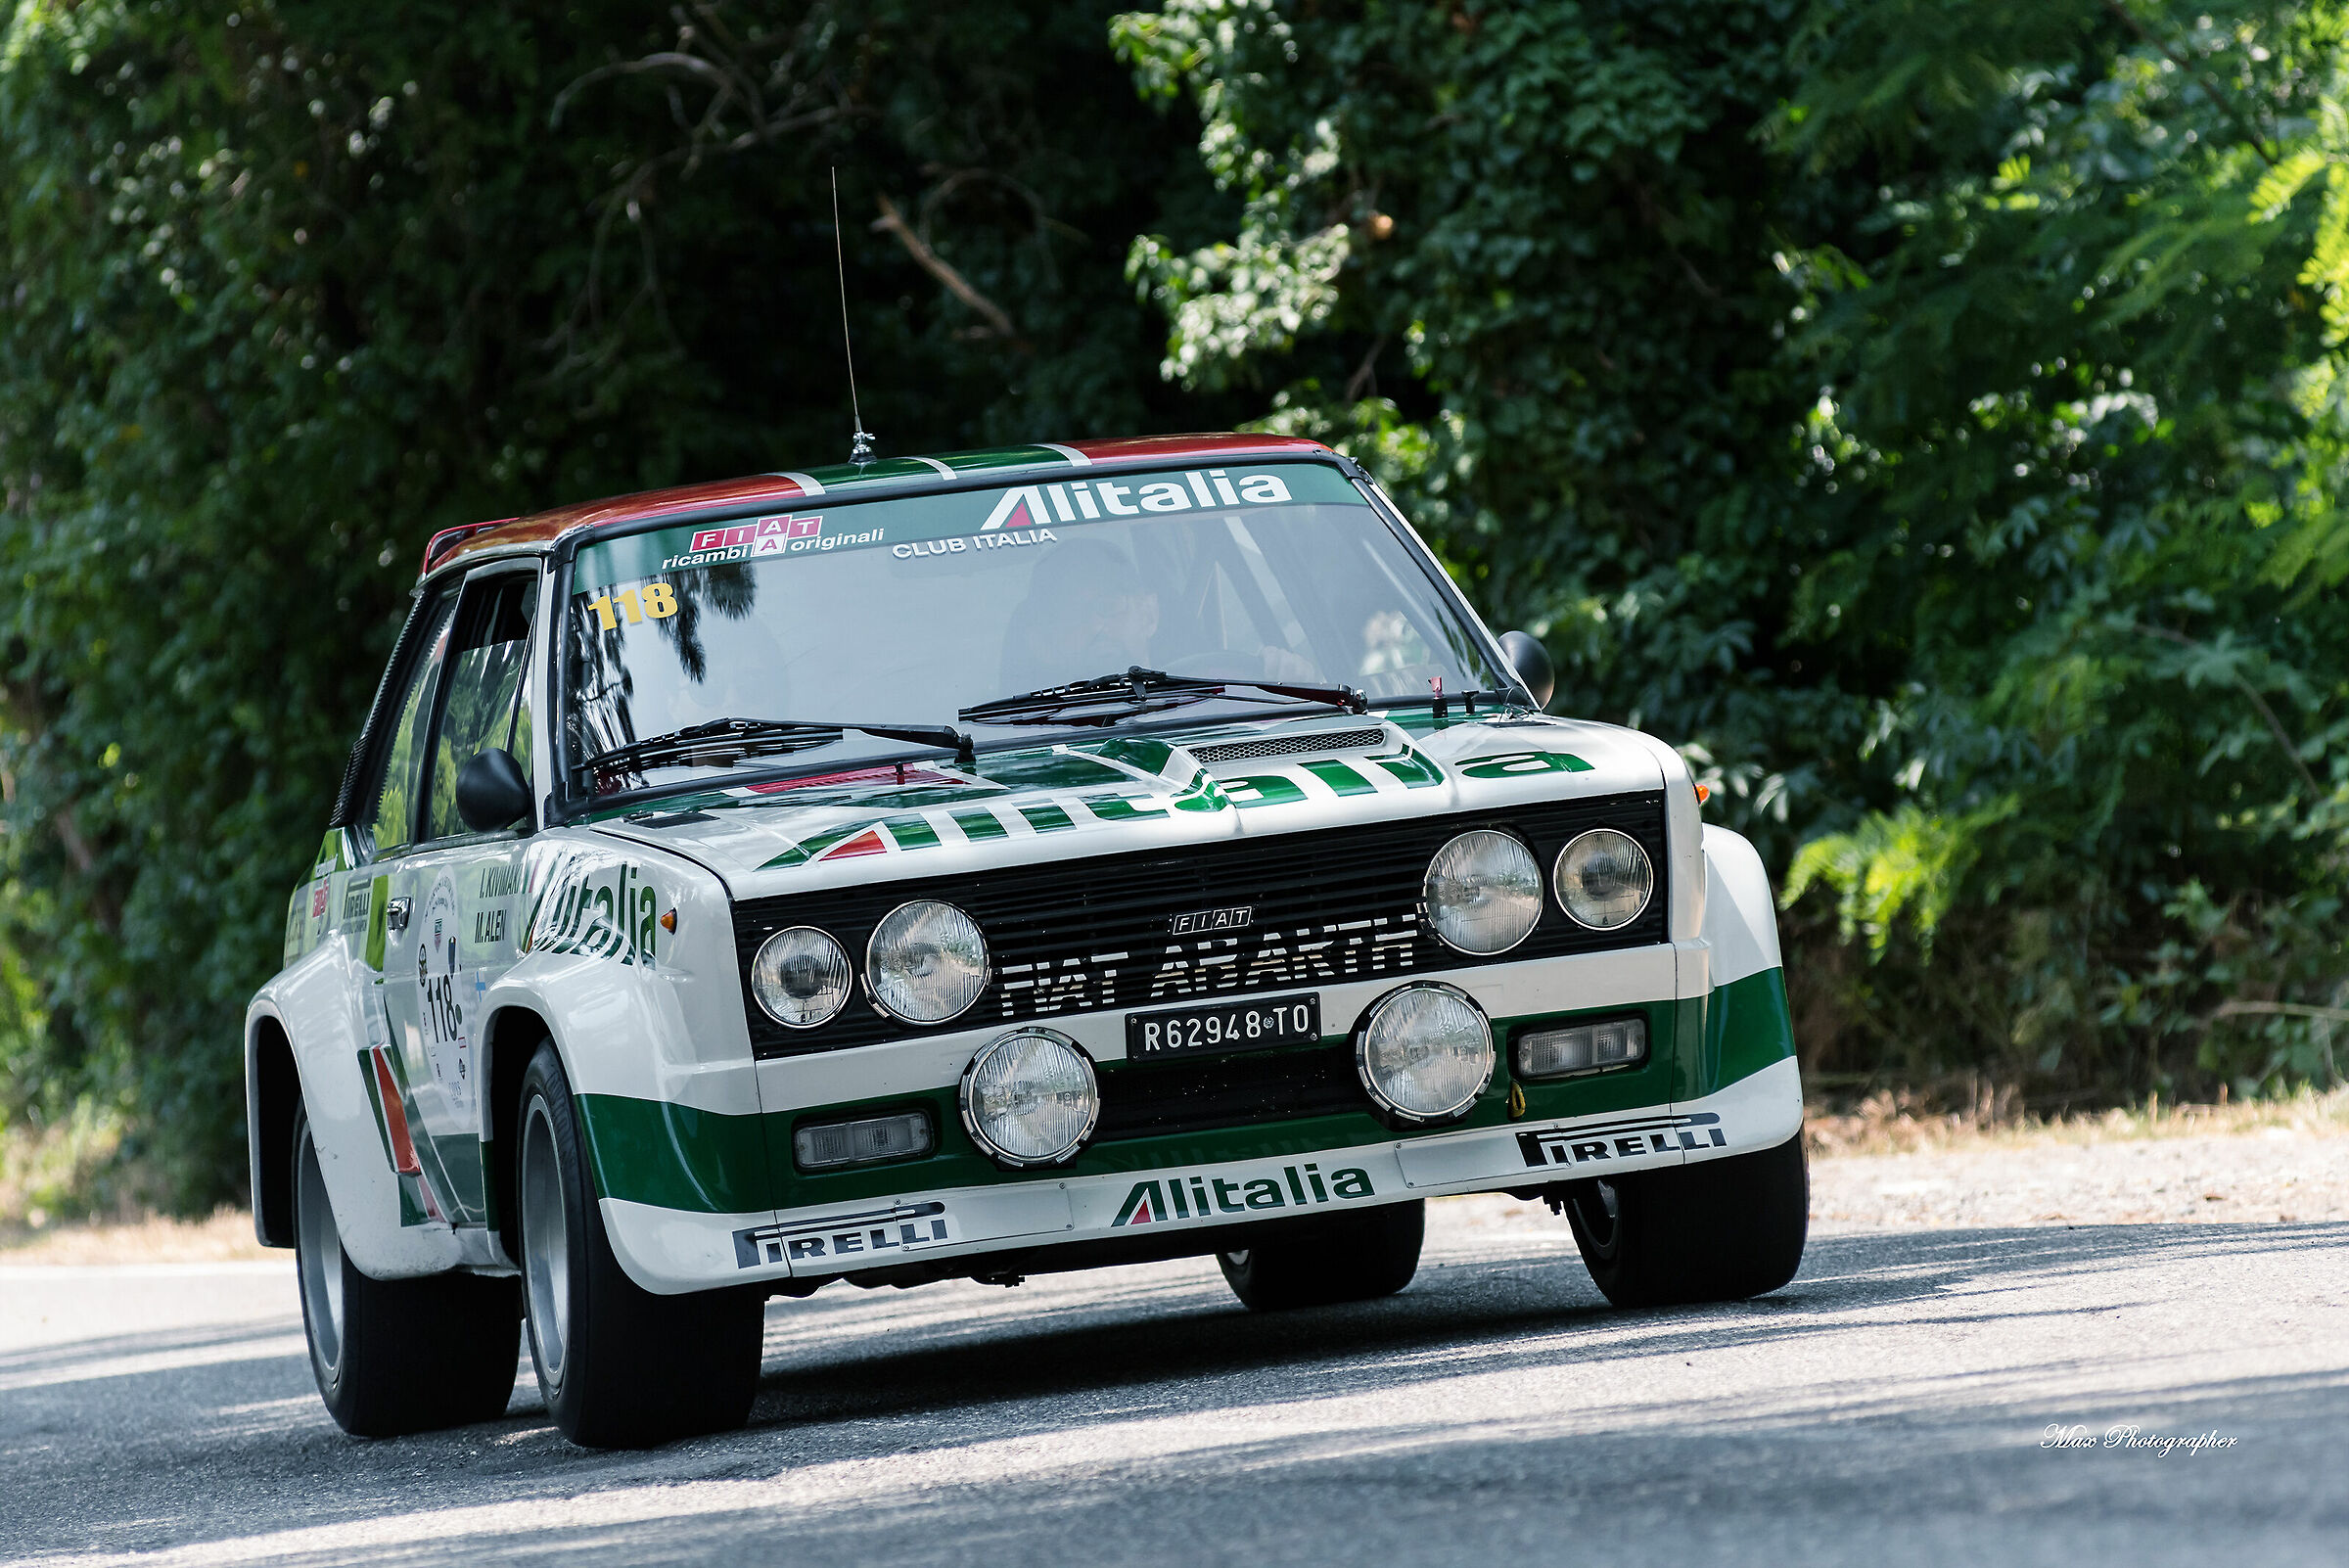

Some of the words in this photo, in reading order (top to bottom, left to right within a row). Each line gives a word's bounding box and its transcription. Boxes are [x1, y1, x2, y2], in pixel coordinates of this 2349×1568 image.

[981, 470, 1292, 530] Alitalia
[661, 545, 749, 570] ricambi
[791, 528, 885, 553] originali
[693, 517, 820, 551] FIAT
[892, 537, 967, 560] CLUB
[973, 528, 1058, 551] ITALIA
[588, 582, 678, 631] 118
[756, 748, 1594, 870] Alitalia
[1174, 908, 1250, 933] FIAT
[1000, 951, 1128, 1016] FIAT
[1151, 913, 1418, 997] ABARTH
[427, 974, 457, 1043] 118
[1144, 1010, 1262, 1051] R62948
[1515, 1112, 1727, 1168] PIRELLI
[1111, 1163, 1375, 1227] Alitalia
[732, 1201, 947, 1269] PIRELLI
